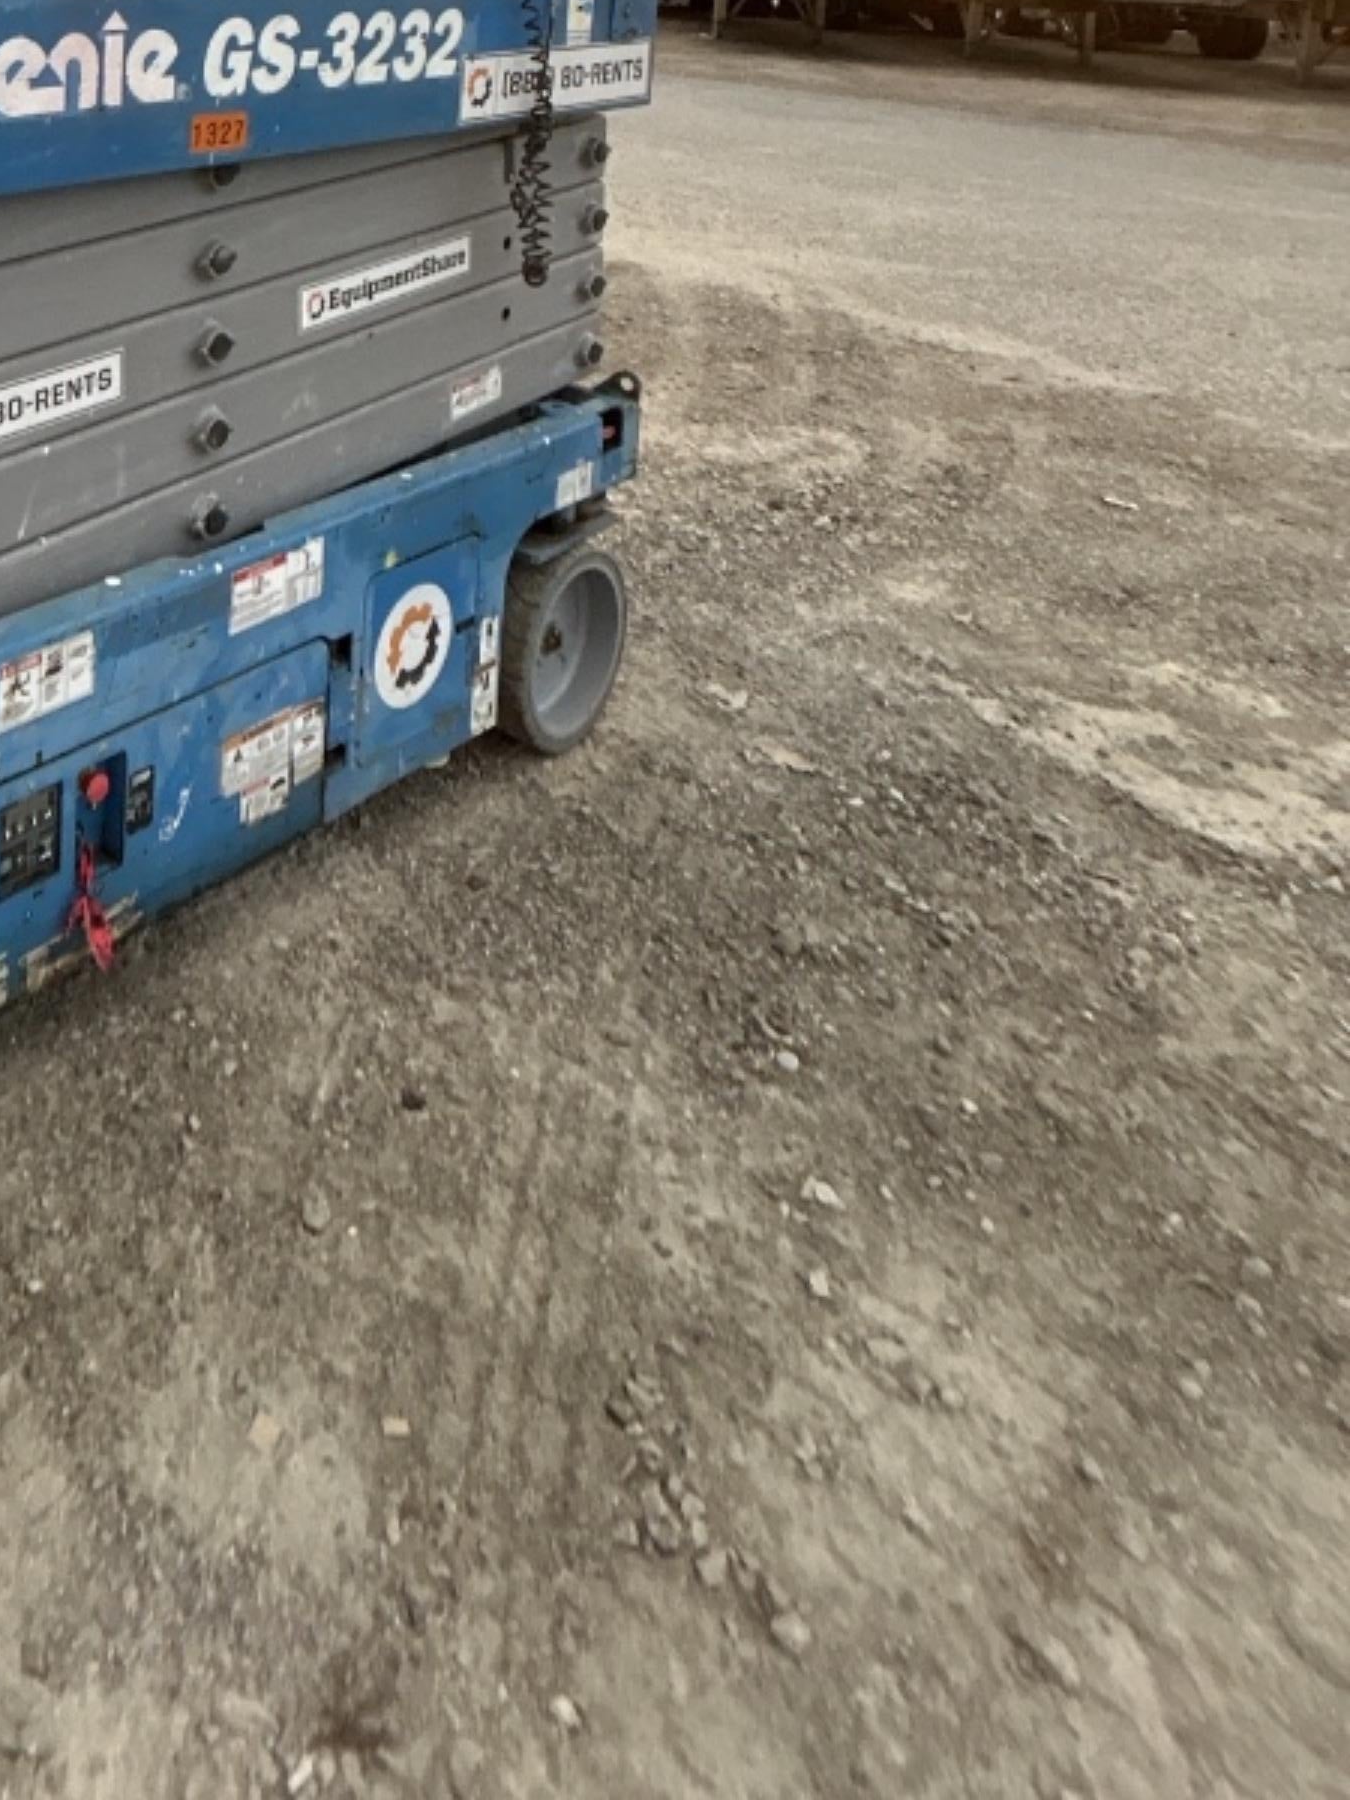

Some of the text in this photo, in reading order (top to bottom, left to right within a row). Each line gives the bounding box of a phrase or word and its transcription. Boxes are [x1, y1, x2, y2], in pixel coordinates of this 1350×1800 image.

[203, 7, 464, 96] GS-3232
[193, 118, 245, 149] 1327
[328, 248, 466, 310] EquipmentShare
